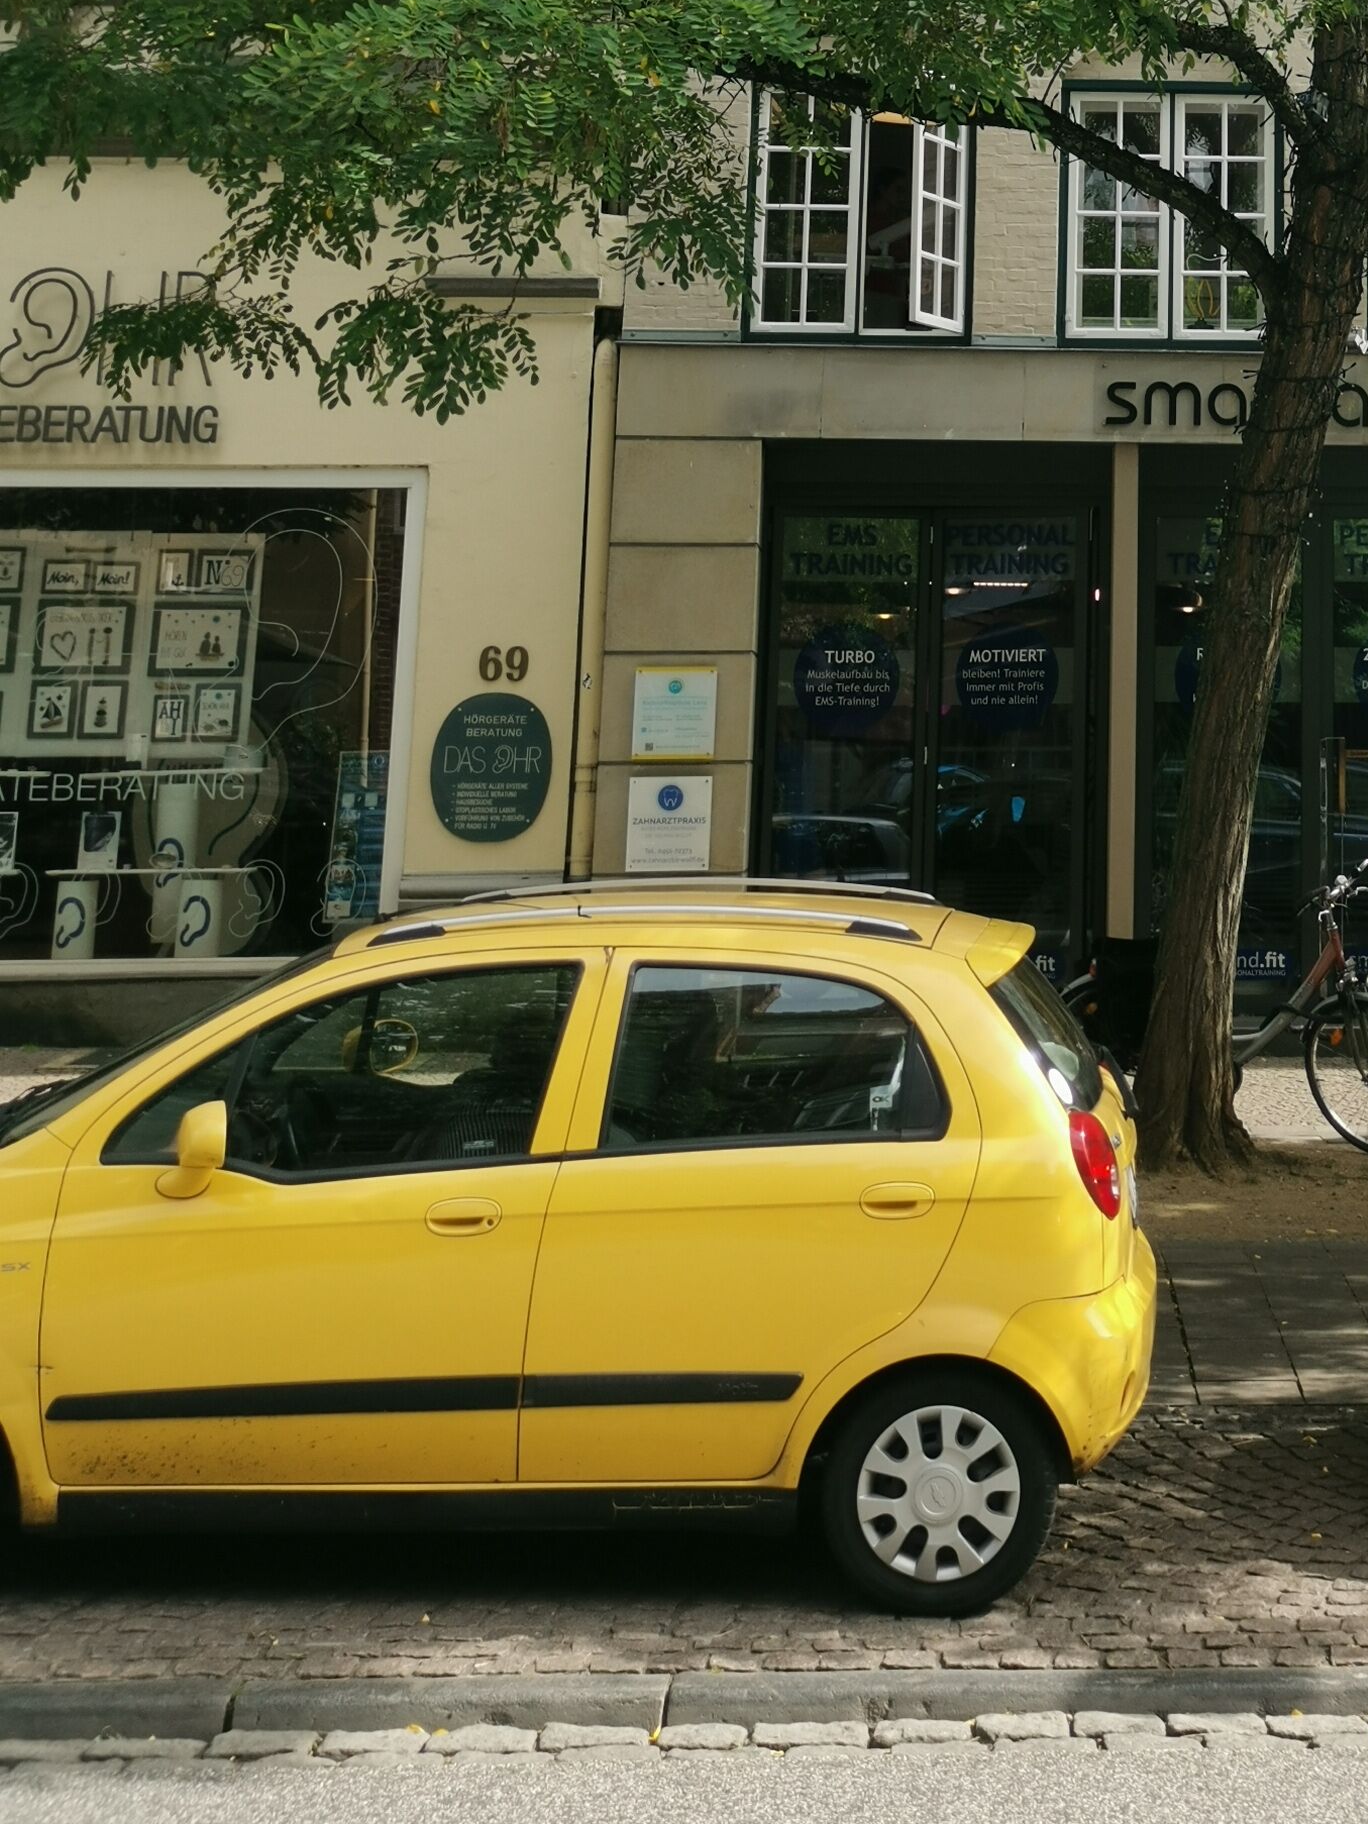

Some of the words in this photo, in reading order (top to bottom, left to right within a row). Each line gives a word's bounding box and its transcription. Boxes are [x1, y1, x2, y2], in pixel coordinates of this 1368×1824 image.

[1105, 381, 1248, 426] sma
[828, 524, 877, 546] EMS
[790, 553, 913, 577] TRAINING
[950, 553, 1069, 577] TRAINING
[824, 650, 876, 664] TURBO
[969, 648, 1047, 663] MOTIVIERT
[479, 645, 530, 682] 69
[807, 669, 872, 679] Muskelaufbau
[875, 669, 891, 681] bis
[962, 668, 1000, 679] bleiben!
[1003, 668, 1045, 678] Trainiere
[817, 683, 833, 693] die
[835, 683, 861, 693] Tiefe
[863, 683, 890, 693] durch
[999, 682, 1015, 692] mit
[1017, 681, 1044, 692] Profis
[815, 696, 880, 708] EMS-Training!
[971, 695, 988, 705] und
[991, 695, 1006, 705] nie
[1008, 694, 1038, 705] allein!
[464, 712, 528, 725] HÖRGERÄTE
[466, 728, 523, 737] BERATUNG
[443, 745, 486, 774] DAS
[632, 817, 706, 825] ZAHNARZTPRAXIS
[1237, 951, 1286, 968] nd.fit
